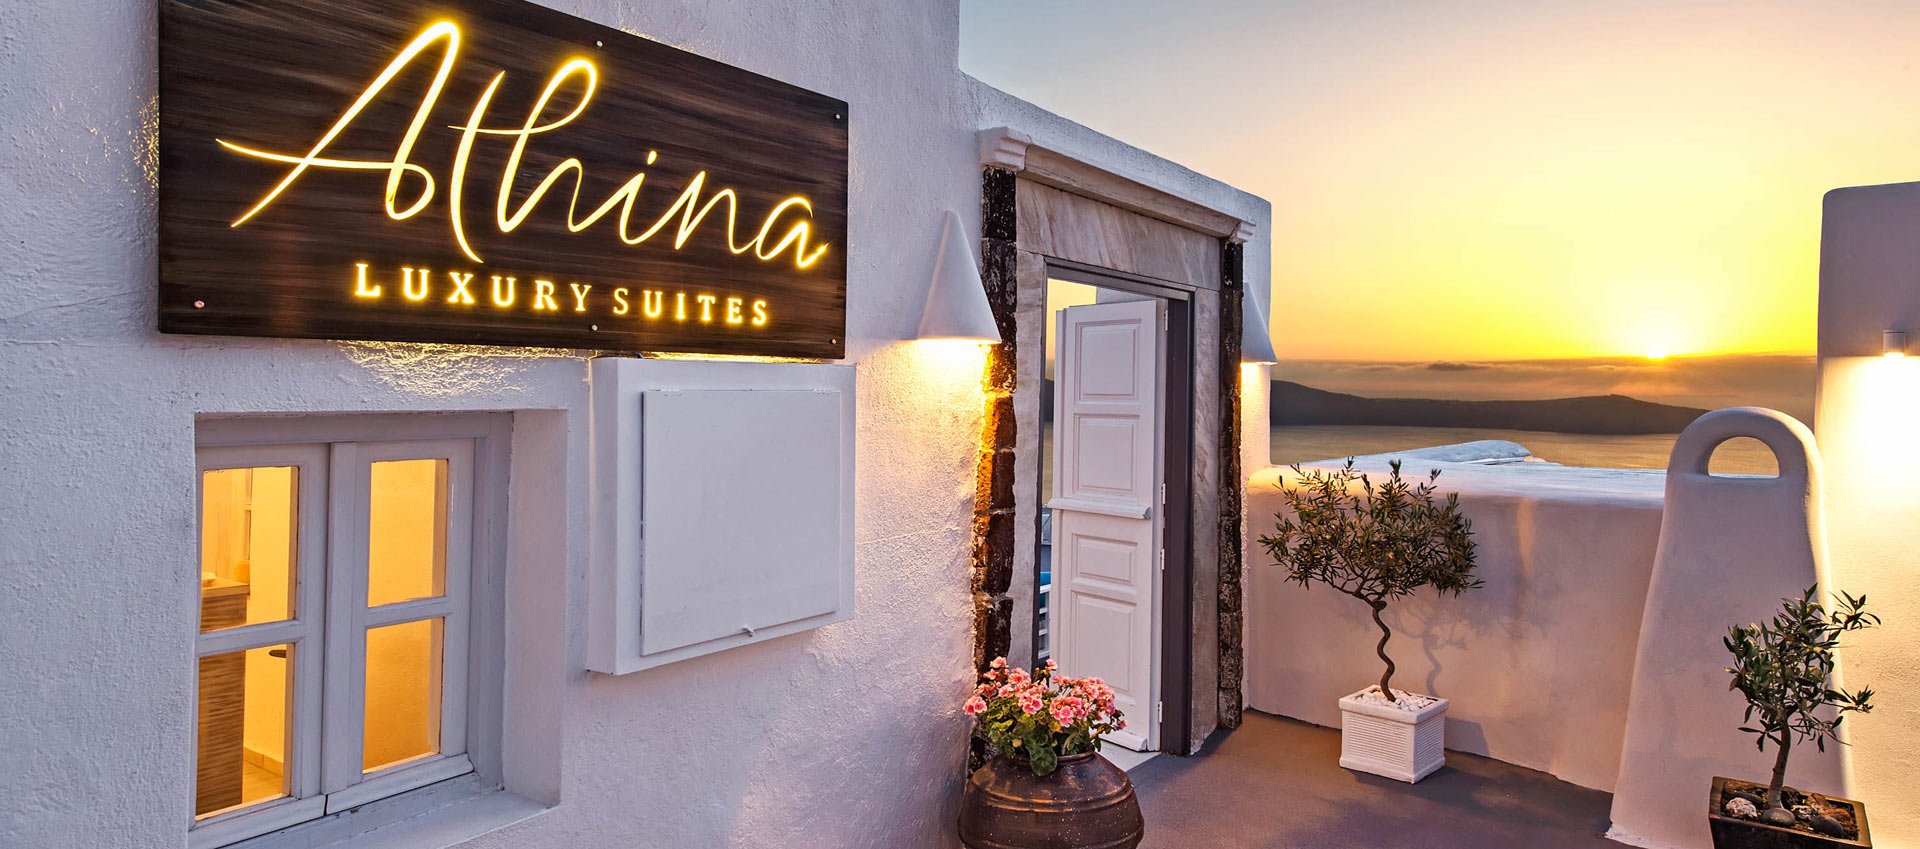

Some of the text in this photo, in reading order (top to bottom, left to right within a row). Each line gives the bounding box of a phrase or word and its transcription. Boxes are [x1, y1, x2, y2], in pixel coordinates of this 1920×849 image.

[216, 21, 829, 269] Athina
[355, 263, 768, 327] LUXURY SUITES
